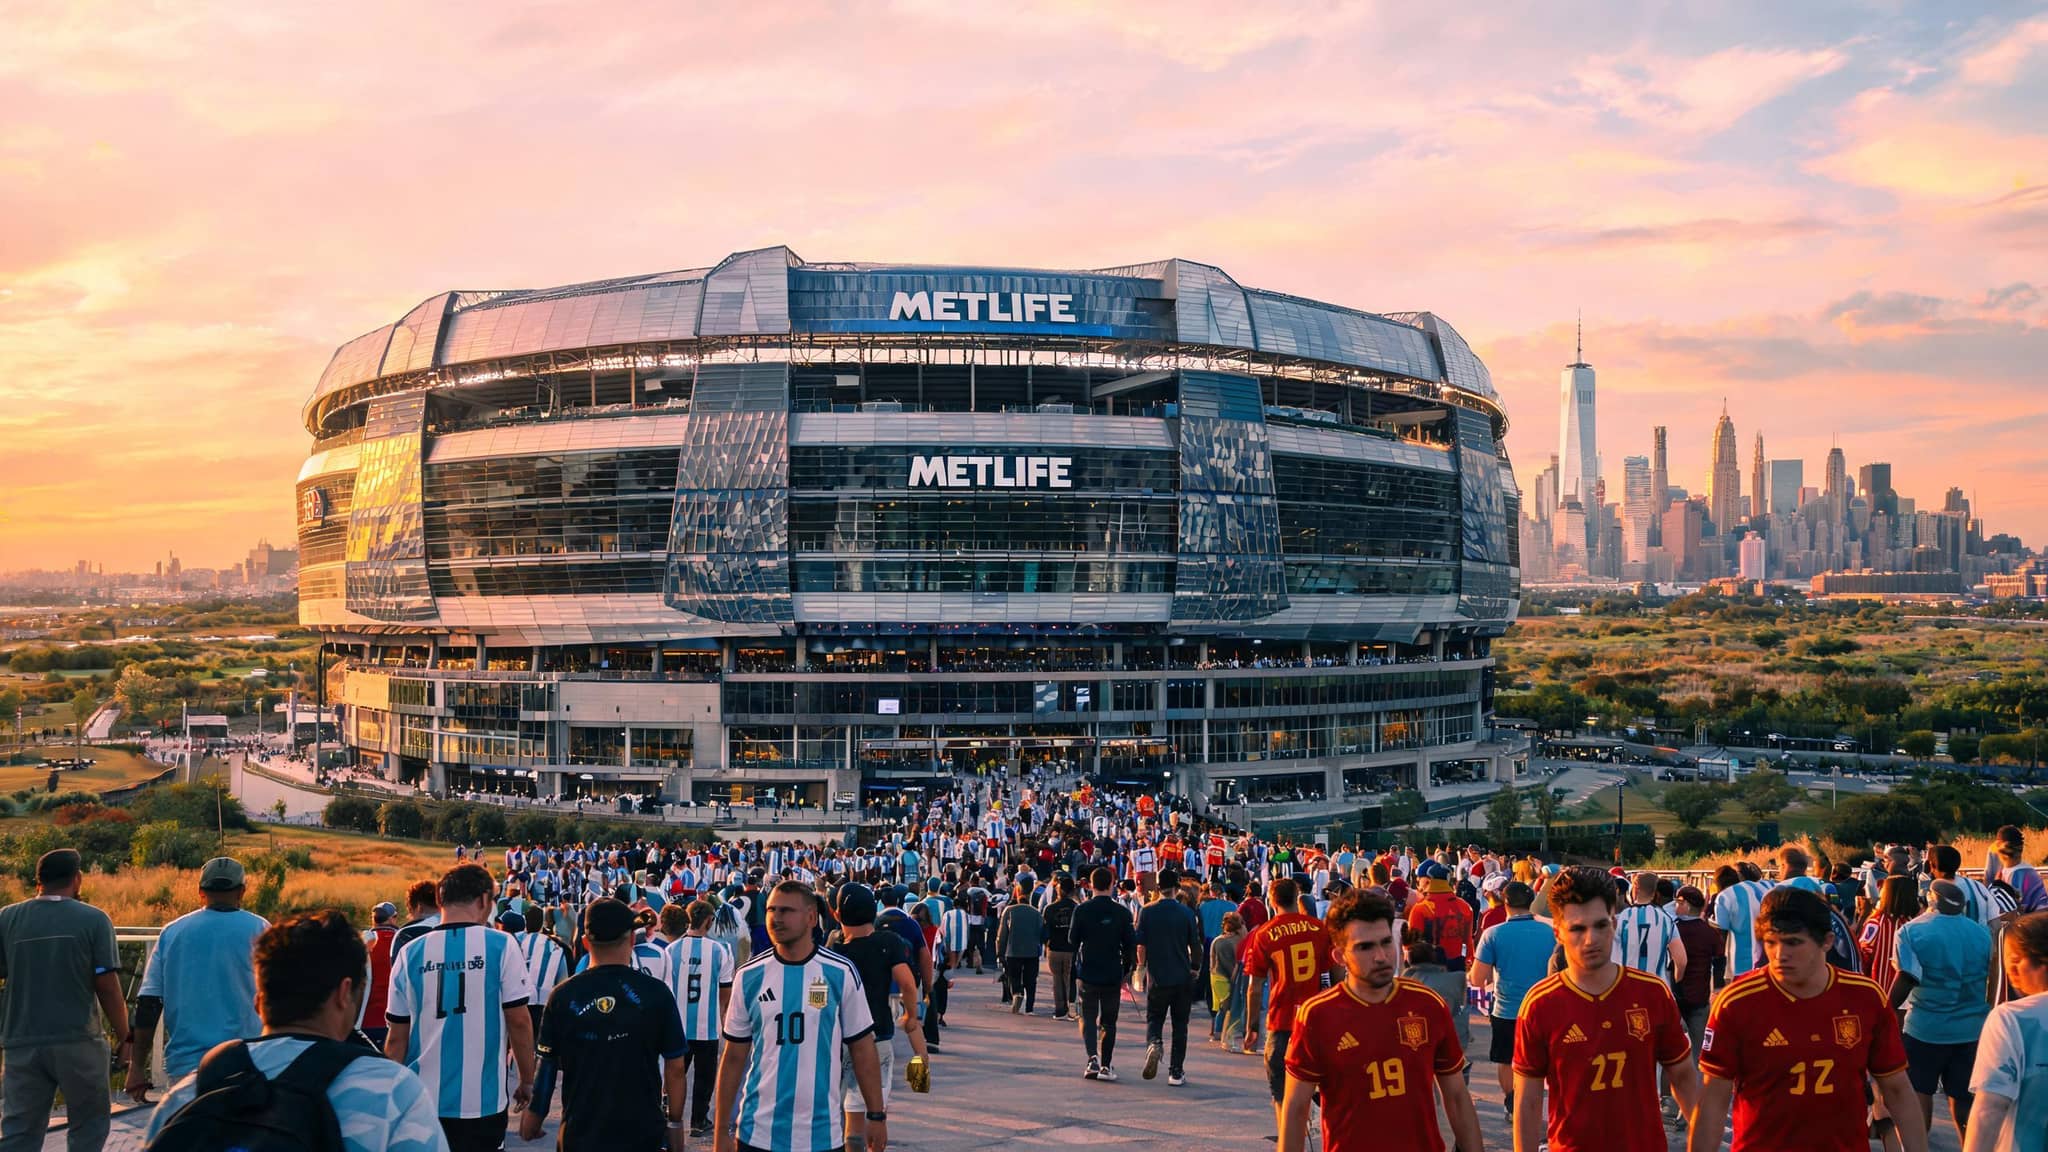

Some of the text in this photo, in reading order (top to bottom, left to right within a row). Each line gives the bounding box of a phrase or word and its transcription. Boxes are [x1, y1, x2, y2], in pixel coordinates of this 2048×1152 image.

[889, 291, 1076, 323] METLIFE
[908, 456, 1072, 488] METLIFE
[774, 1011, 805, 1046] 10
[1366, 1058, 1406, 1100] 19
